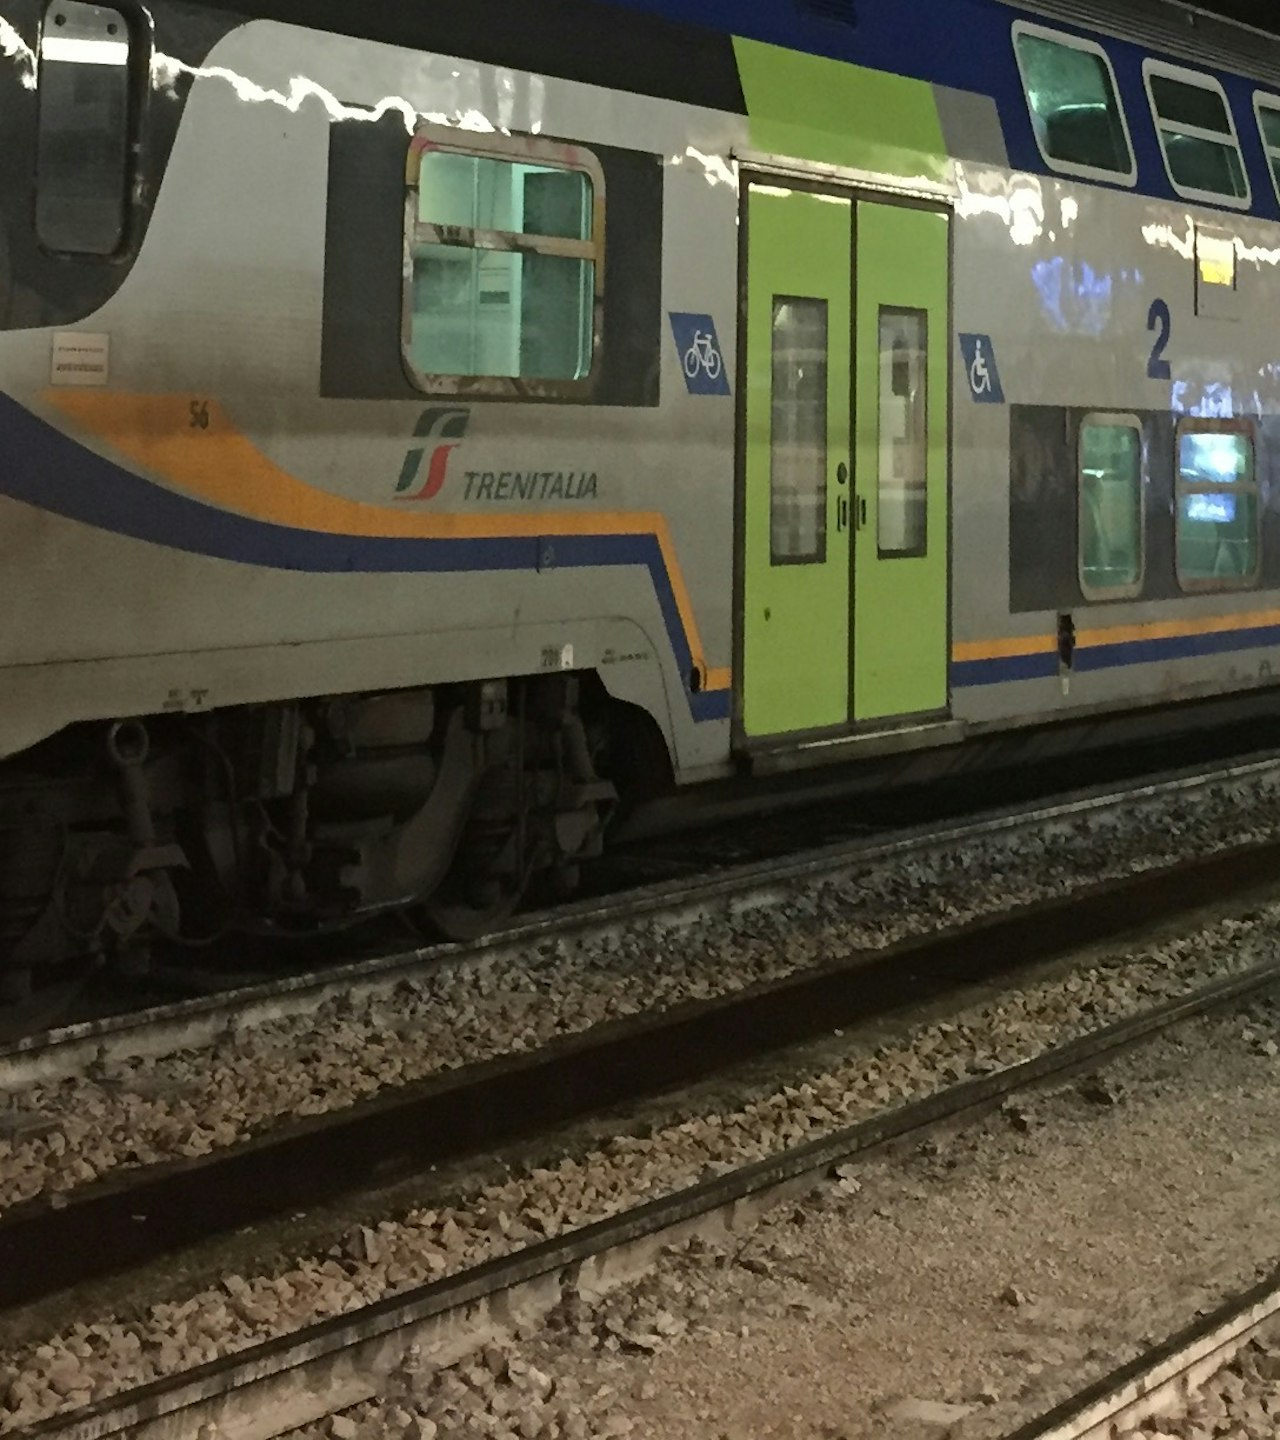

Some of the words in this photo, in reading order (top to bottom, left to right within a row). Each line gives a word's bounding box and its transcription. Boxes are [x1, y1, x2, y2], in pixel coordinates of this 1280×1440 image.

[1147, 298, 1171, 380] 2
[189, 400, 209, 429] 56
[464, 470, 598, 501] TRENITALIA
